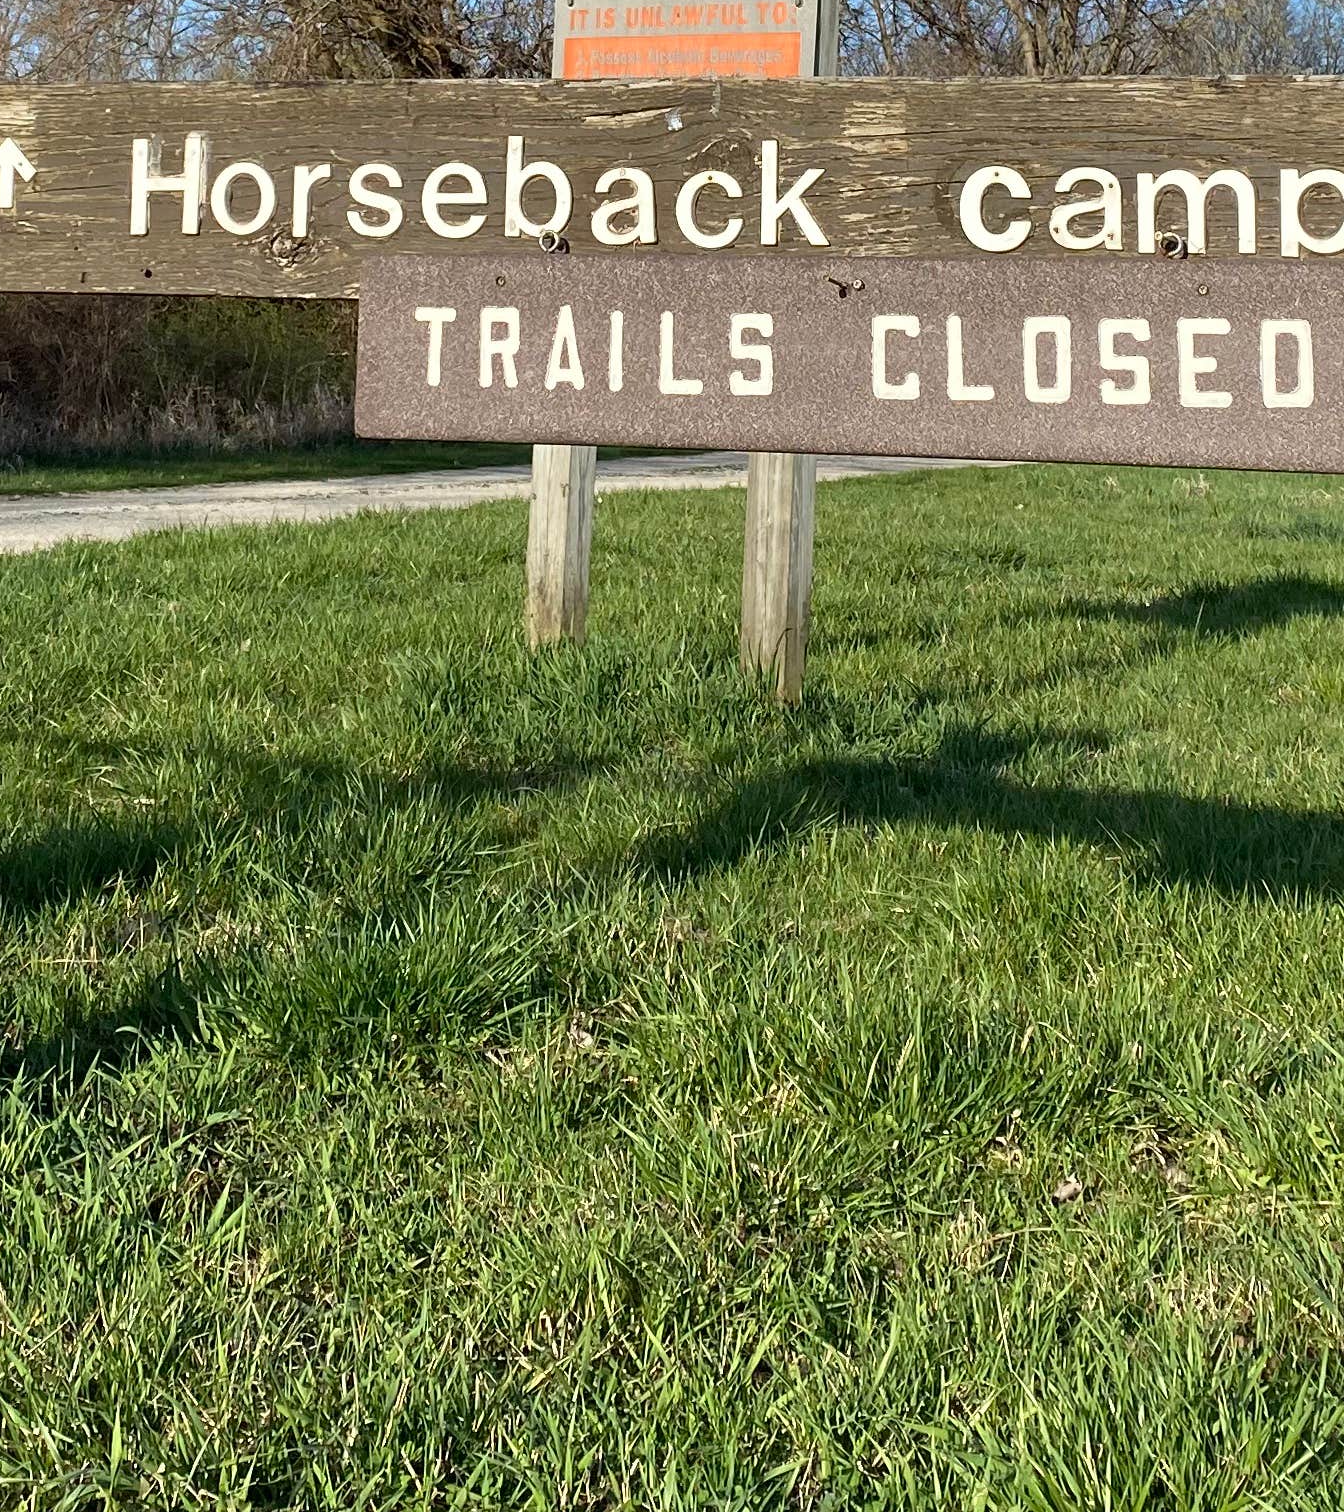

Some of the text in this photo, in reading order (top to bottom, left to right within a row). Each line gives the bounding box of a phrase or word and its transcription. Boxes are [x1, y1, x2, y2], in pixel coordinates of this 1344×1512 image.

[569, 9, 589, 31] IT
[596, 7, 616, 29] IS
[625, 2, 748, 29] UNLAWFUL
[130, 134, 831, 249] Horseback
[414, 305, 1316, 410] TRAILS CLOSED
